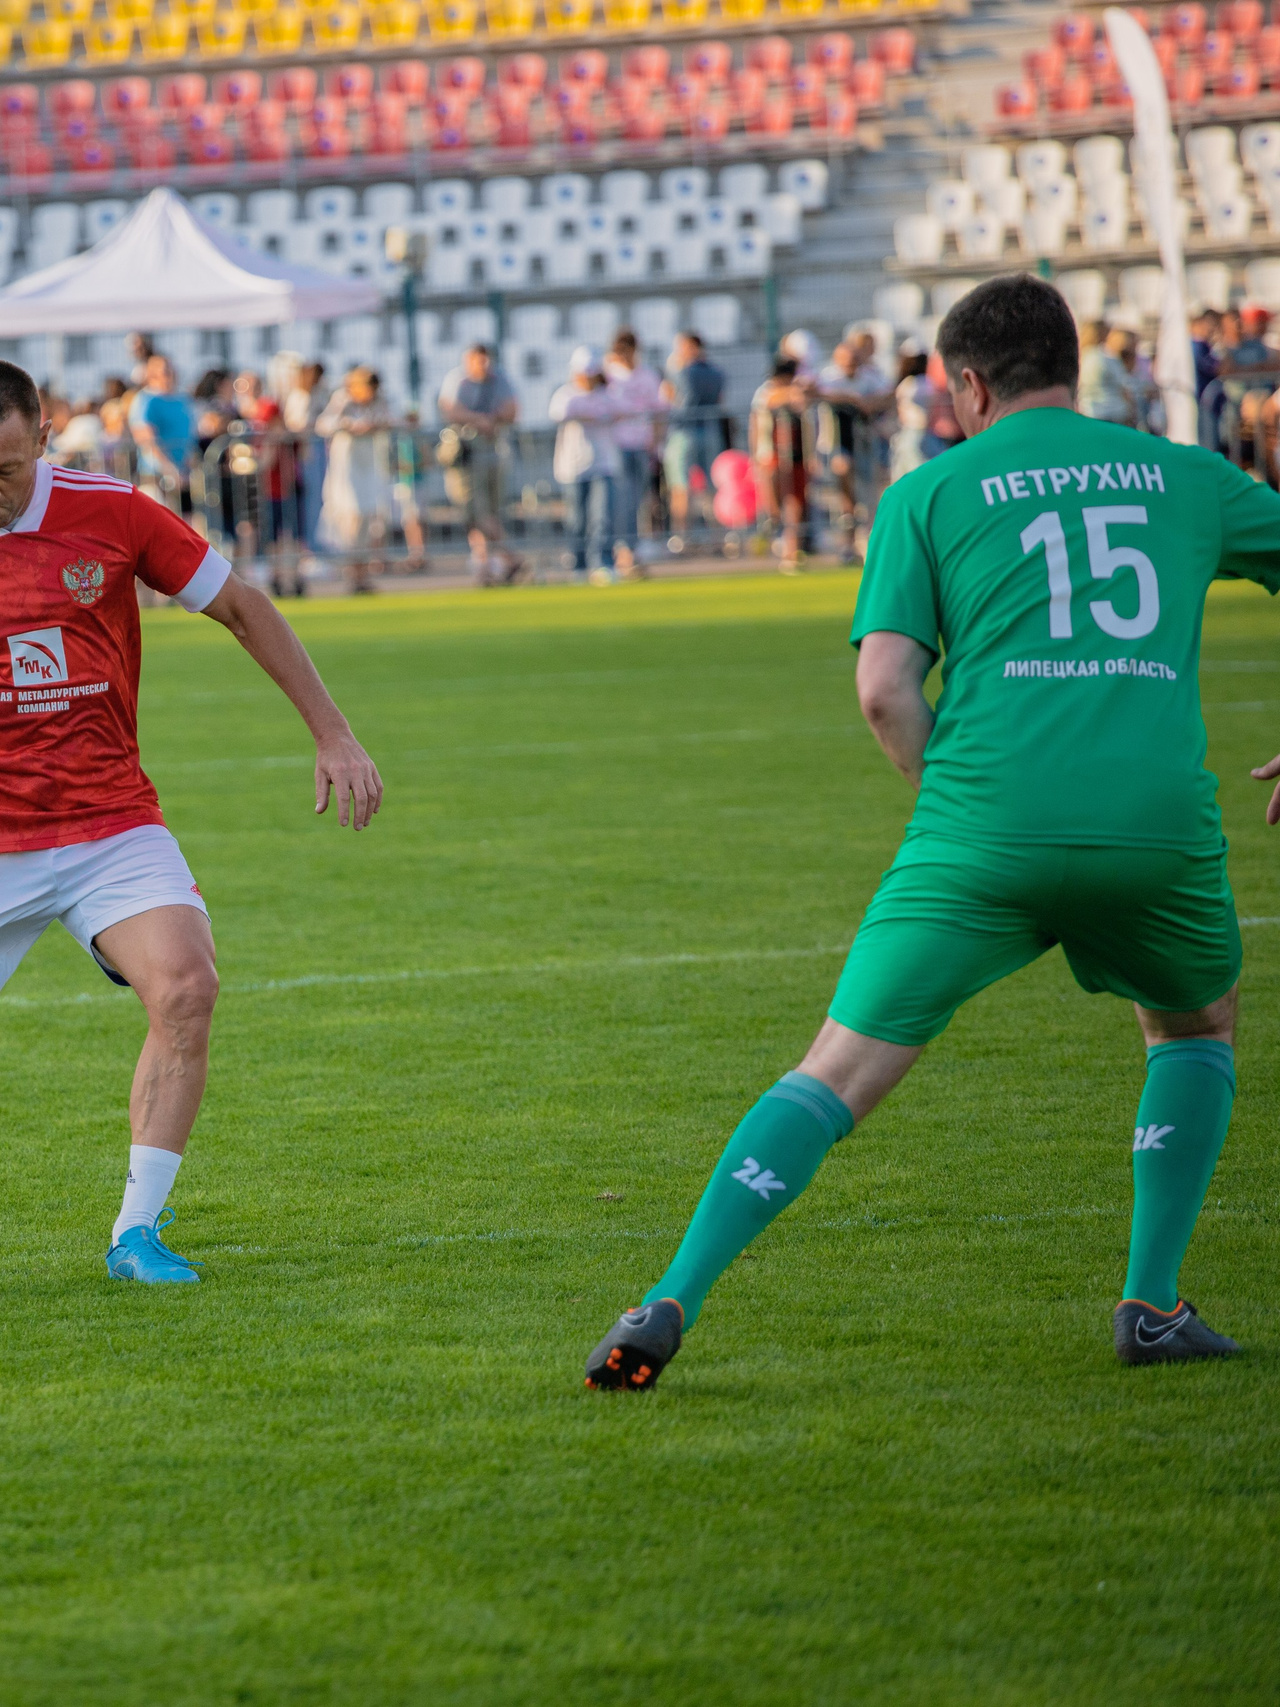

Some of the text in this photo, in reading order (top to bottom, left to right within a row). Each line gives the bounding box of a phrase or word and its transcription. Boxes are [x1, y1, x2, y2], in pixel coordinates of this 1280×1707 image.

[980, 461, 1166, 506] ПЕТРУХИН
[1019, 504, 1161, 641] 15
[14, 655, 54, 680] ТМК
[1002, 657, 1178, 681] ЛИПЕЦКАЯ ОБЛАСТЬ
[18, 681, 110, 702] МЕТАЛЛУРГИЧЕСКАЯ
[17, 700, 70, 714] КОМПАНИЯ
[730, 1155, 787, 1201] 2K
